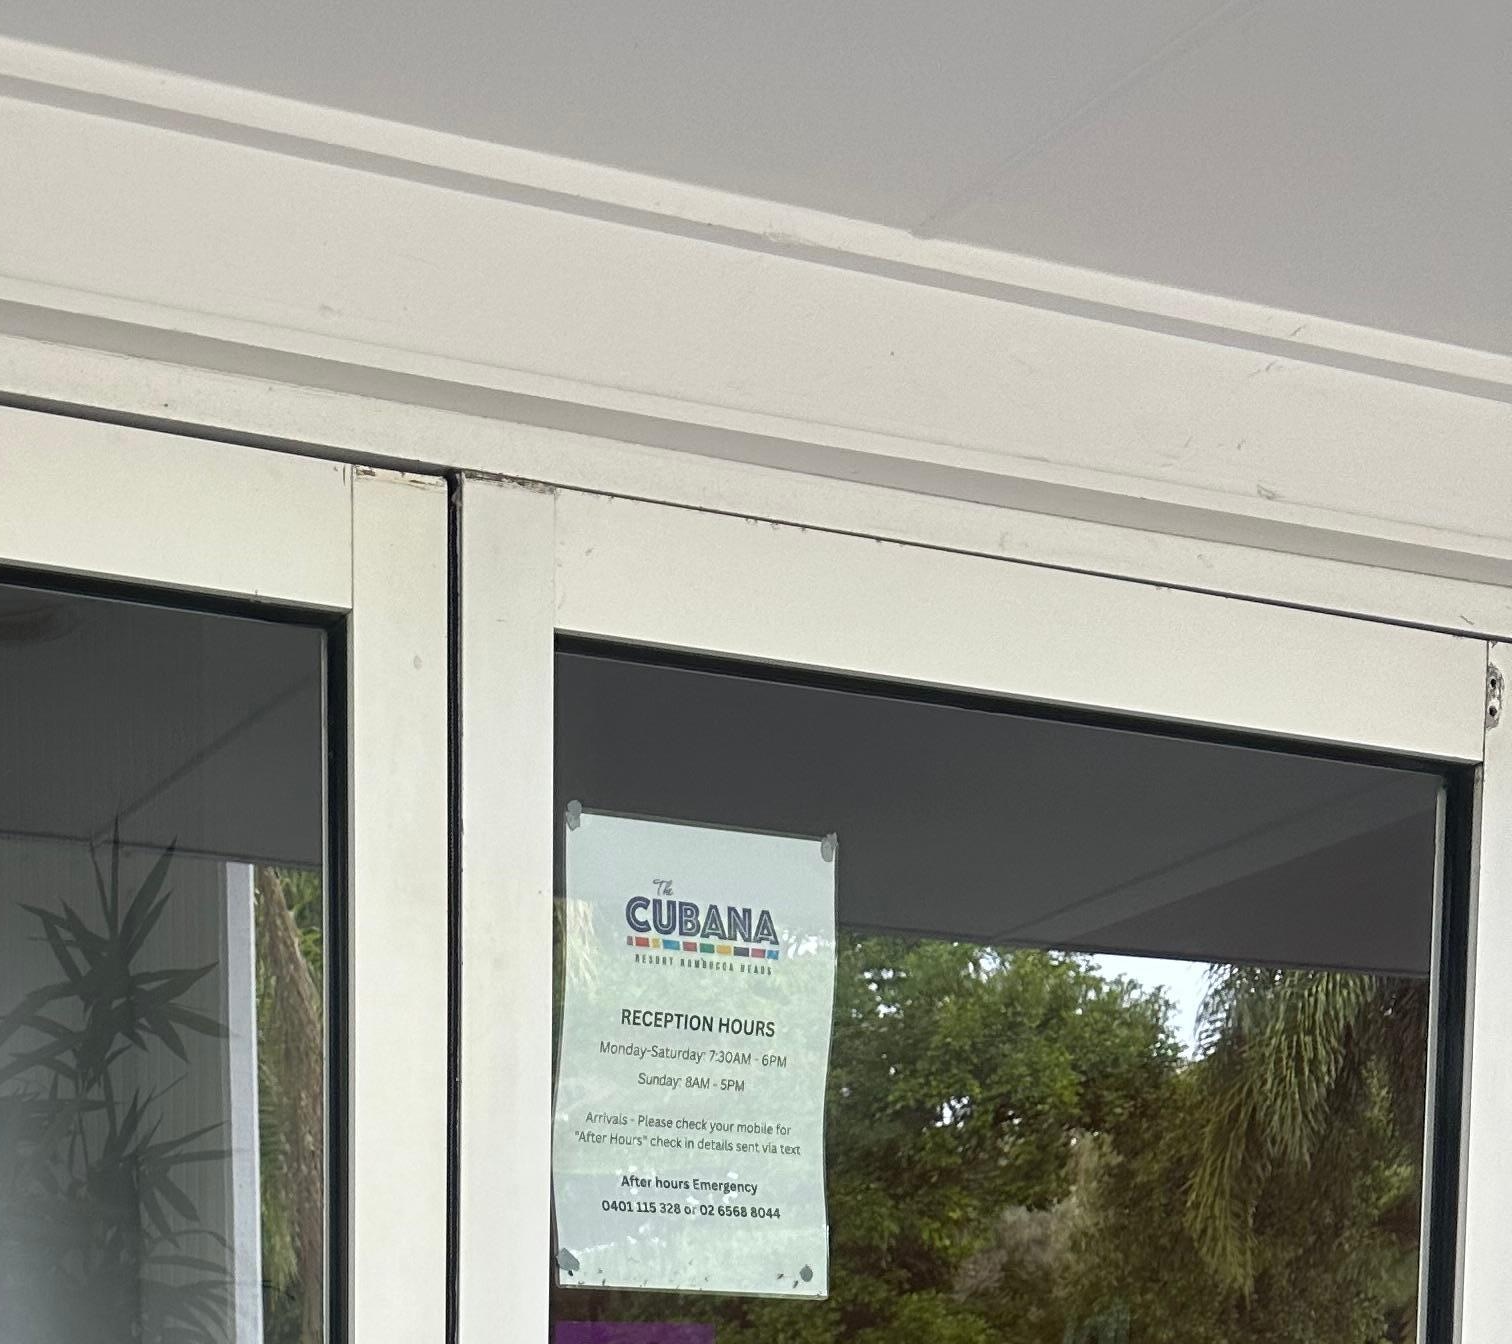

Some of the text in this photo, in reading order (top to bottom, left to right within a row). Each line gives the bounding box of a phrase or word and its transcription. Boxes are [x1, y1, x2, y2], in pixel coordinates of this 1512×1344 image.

[653, 879, 674, 896] The
[626, 896, 779, 945] CUBANA
[621, 1009, 776, 1037] RECEPTION HOURS
[709, 1050, 752, 1065] 7:30AM
[761, 1054, 787, 1068] 6PM
[685, 1077, 711, 1090] 8AM
[721, 1079, 745, 1092] 5PM
[585, 1112, 628, 1126] Arrivals
[638, 1115, 673, 1129] Please
[676, 1117, 707, 1131] check
[710, 1121, 735, 1134] your
[737, 1122, 774, 1136] mobile
[776, 1123, 792, 1137] for
[650, 1136, 682, 1149] check
[685, 1138, 695, 1150] in
[697, 1138, 734, 1152] details
[736, 1141, 760, 1154] sent
[762, 1143, 778, 1155] via
[780, 1143, 801, 1156] text
[621, 1176, 758, 1196] After hours Emergency
[602, 1200, 781, 1219] 0401 115 328 or 02 6568 8044
